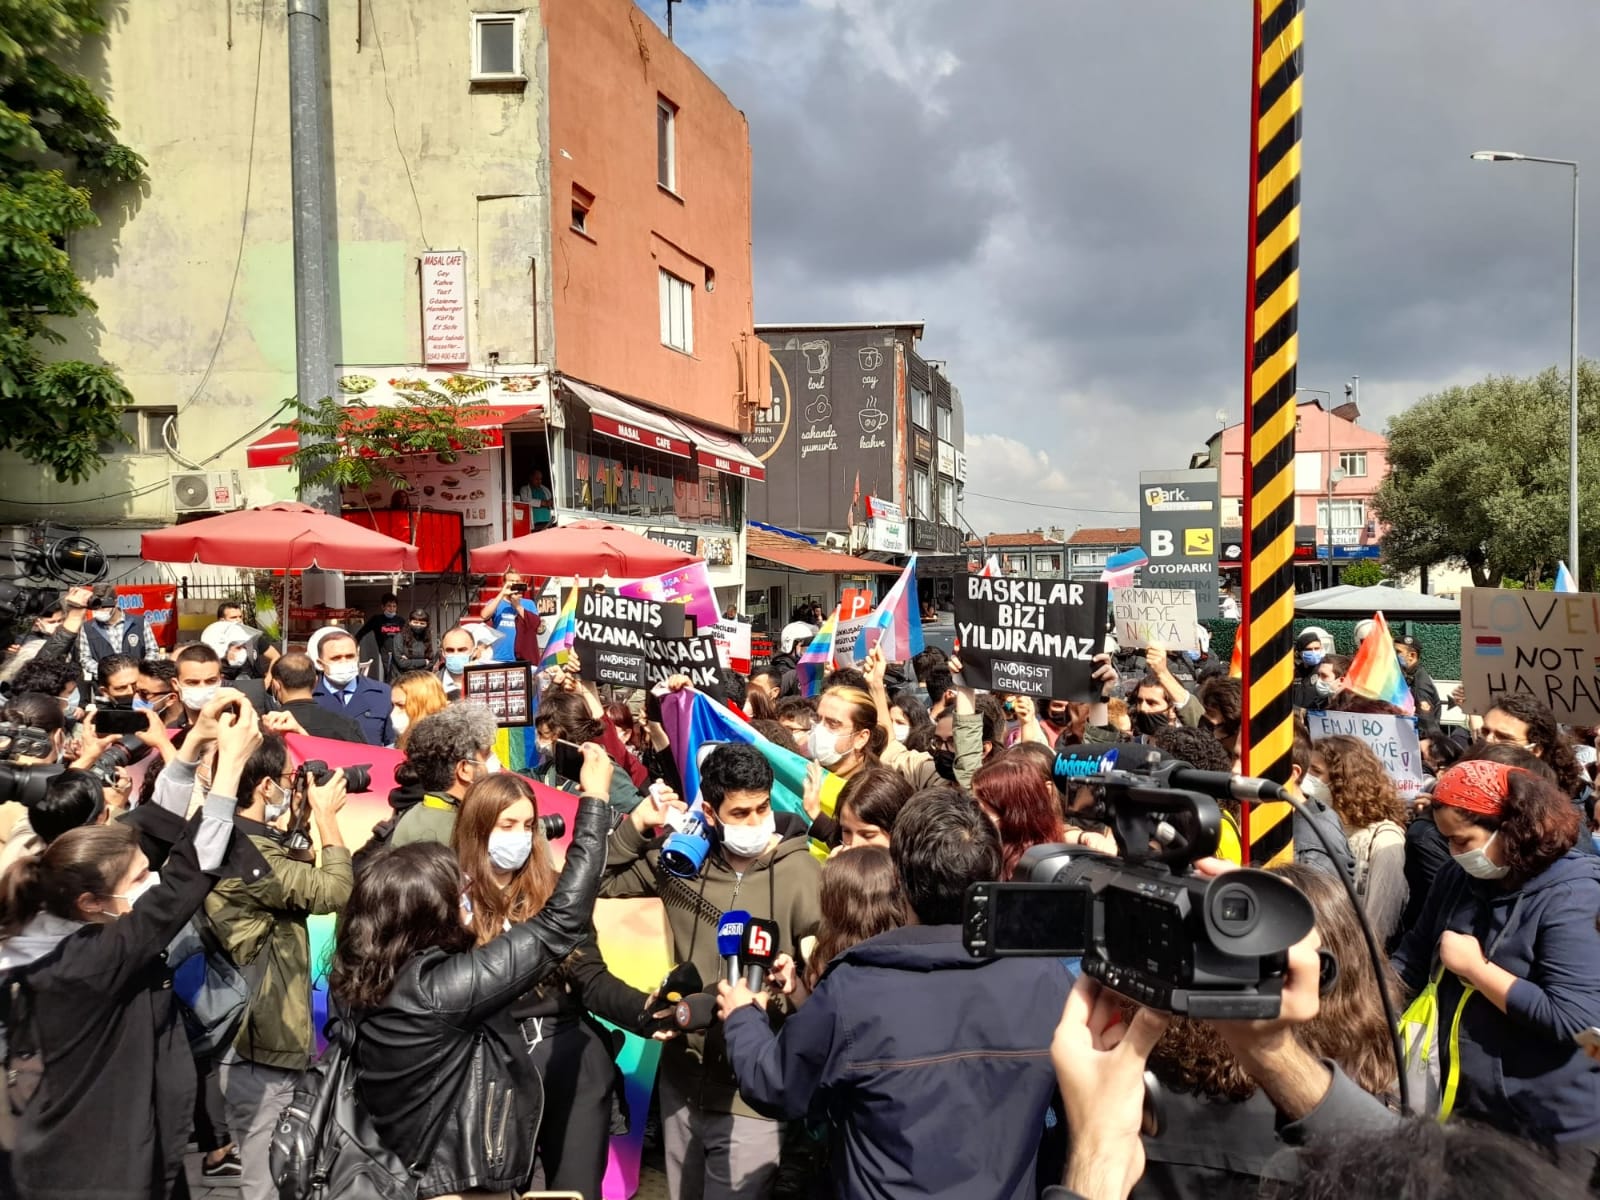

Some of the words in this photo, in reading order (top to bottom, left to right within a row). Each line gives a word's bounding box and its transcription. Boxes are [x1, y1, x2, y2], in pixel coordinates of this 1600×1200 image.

[424, 256, 444, 266] MASAL
[446, 256, 462, 266] CAFE
[426, 305, 462, 313] Hamburger
[808, 376, 825, 390] tost
[862, 376, 879, 389] çay
[618, 424, 640, 441] MASAL
[655, 436, 671, 450] CAFE
[801, 424, 838, 439] sahanda
[801, 438, 838, 458] yumurta
[860, 434, 887, 449] kahve
[715, 457, 731, 470] MASAL
[739, 465, 751, 475] CAFE
[1151, 530, 1174, 557] B
[1149, 563, 1212, 574] OTOPARKI
[968, 576, 1084, 606] BASKILAR
[117, 594, 145, 610] ASAL
[583, 593, 662, 628] DİRENİŞ
[999, 603, 1045, 630] BİZİ
[958, 622, 1095, 661] YILDIRAMAZ
[1515, 646, 1584, 671] NOT
[1362, 719, 1383, 736] BO
